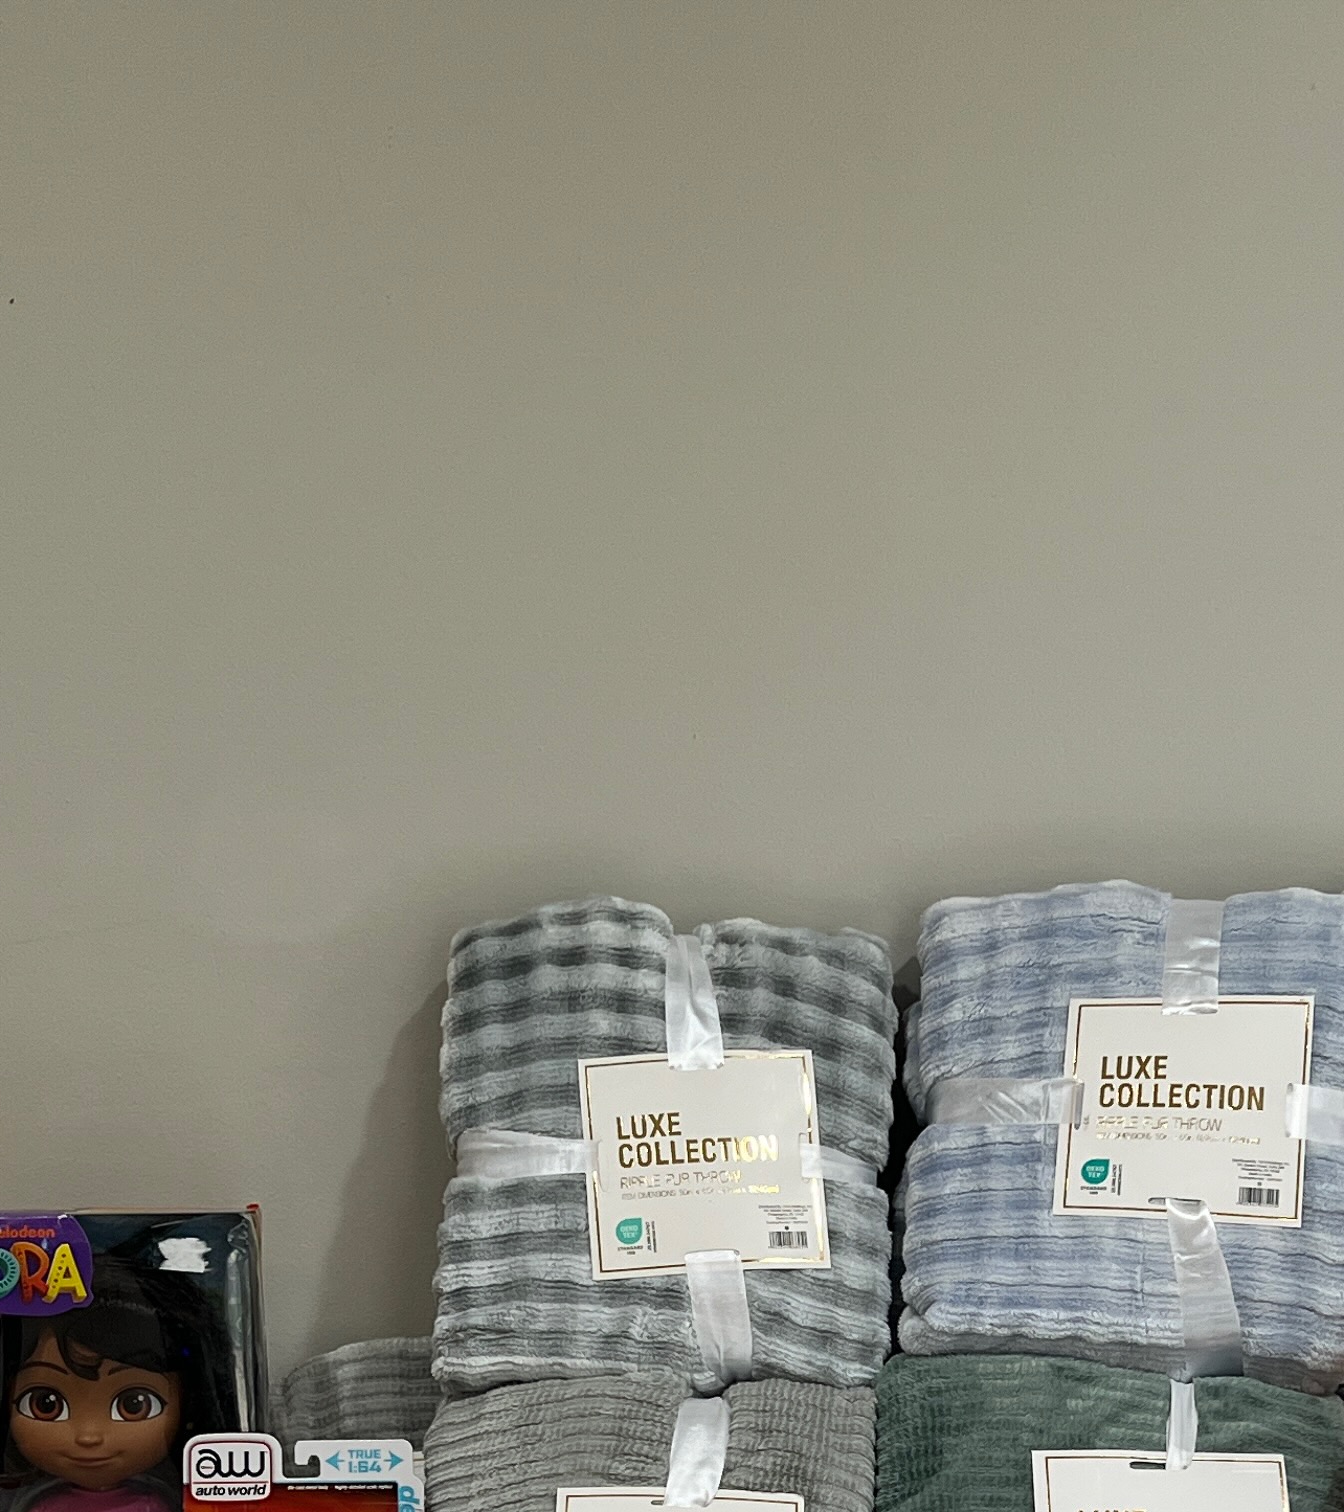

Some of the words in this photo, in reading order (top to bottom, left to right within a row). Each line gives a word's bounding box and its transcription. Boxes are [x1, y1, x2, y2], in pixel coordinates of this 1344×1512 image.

[1100, 1055, 1168, 1080] LUXE
[1099, 1083, 1265, 1111] COLLECTION
[616, 1112, 682, 1140] LUXE
[618, 1134, 779, 1168] COLLECTION
[347, 1449, 382, 1459] TRUE
[348, 1460, 382, 1473] 1:64
[196, 1486, 226, 1496] auto
[227, 1484, 267, 1496] world
